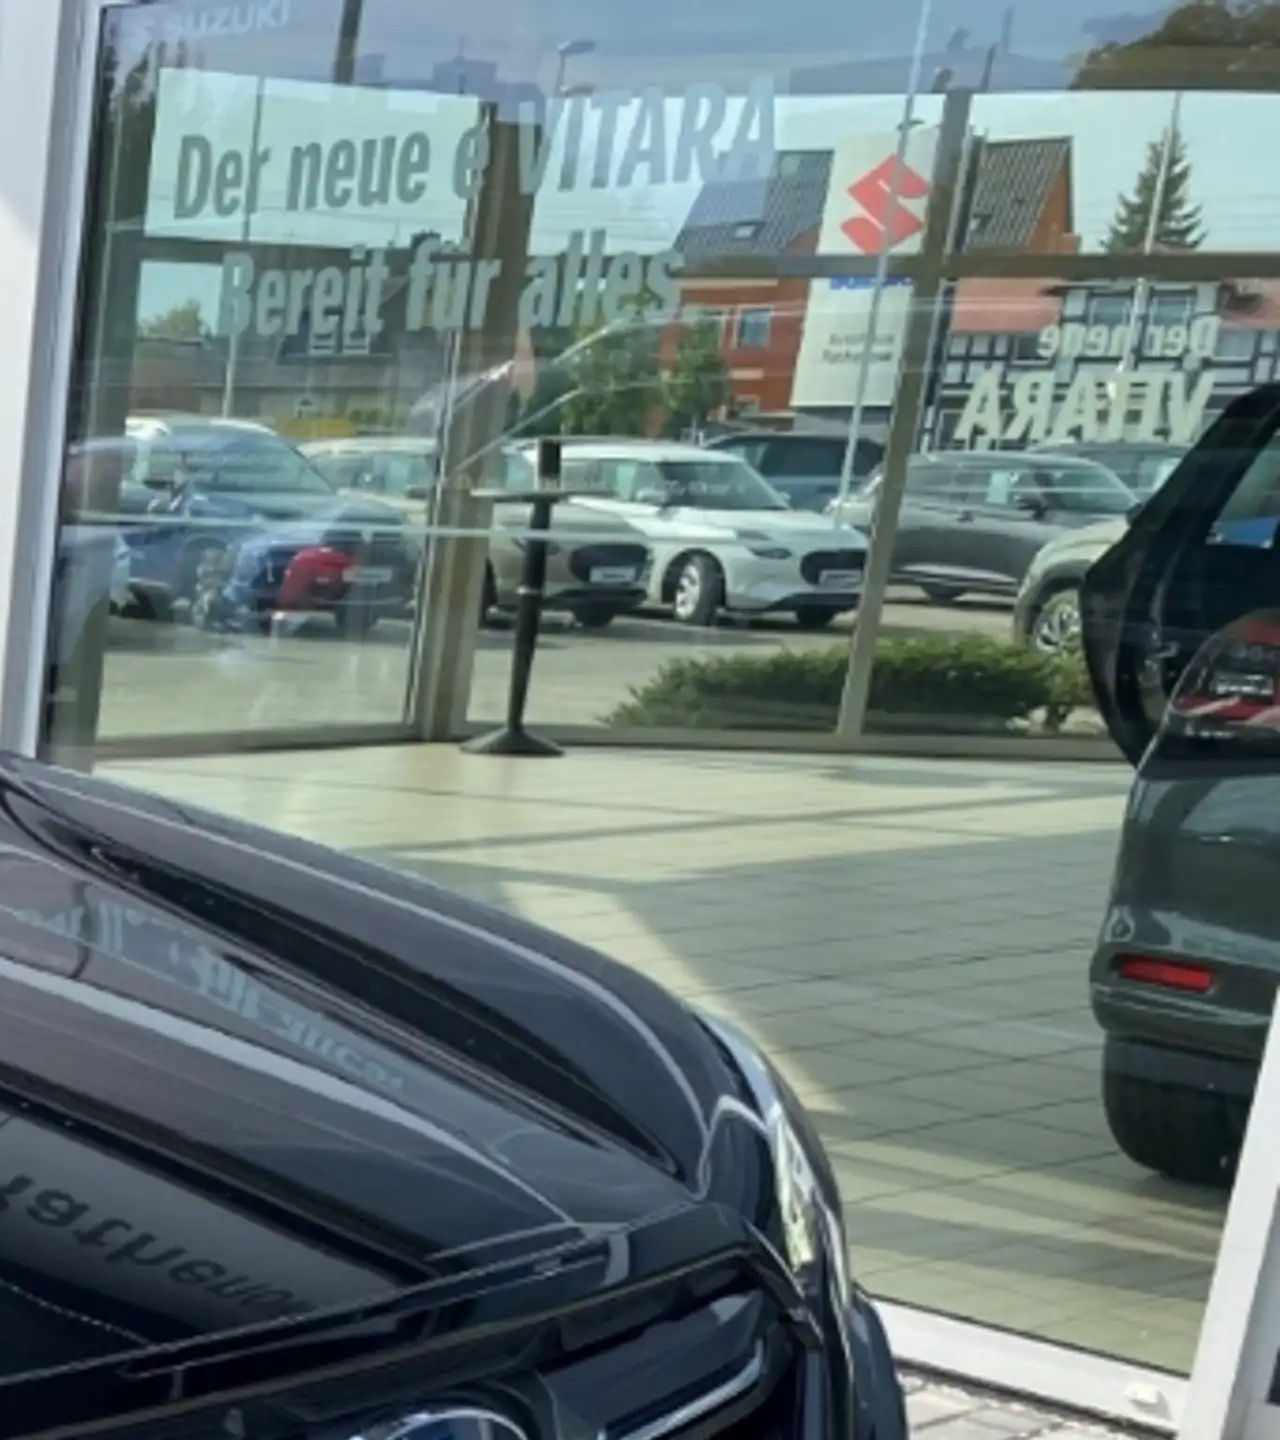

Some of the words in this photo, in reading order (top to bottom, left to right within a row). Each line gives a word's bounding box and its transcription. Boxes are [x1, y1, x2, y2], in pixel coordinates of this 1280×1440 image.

[161, 0, 289, 40] SUZUKI
[173, 134, 272, 219] Der
[286, 131, 431, 211] neue
[452, 125, 491, 200] e
[516, 73, 776, 197] VITARA
[215, 244, 389, 338] Bereit
[405, 238, 502, 332] für
[517, 228, 684, 329] alles
